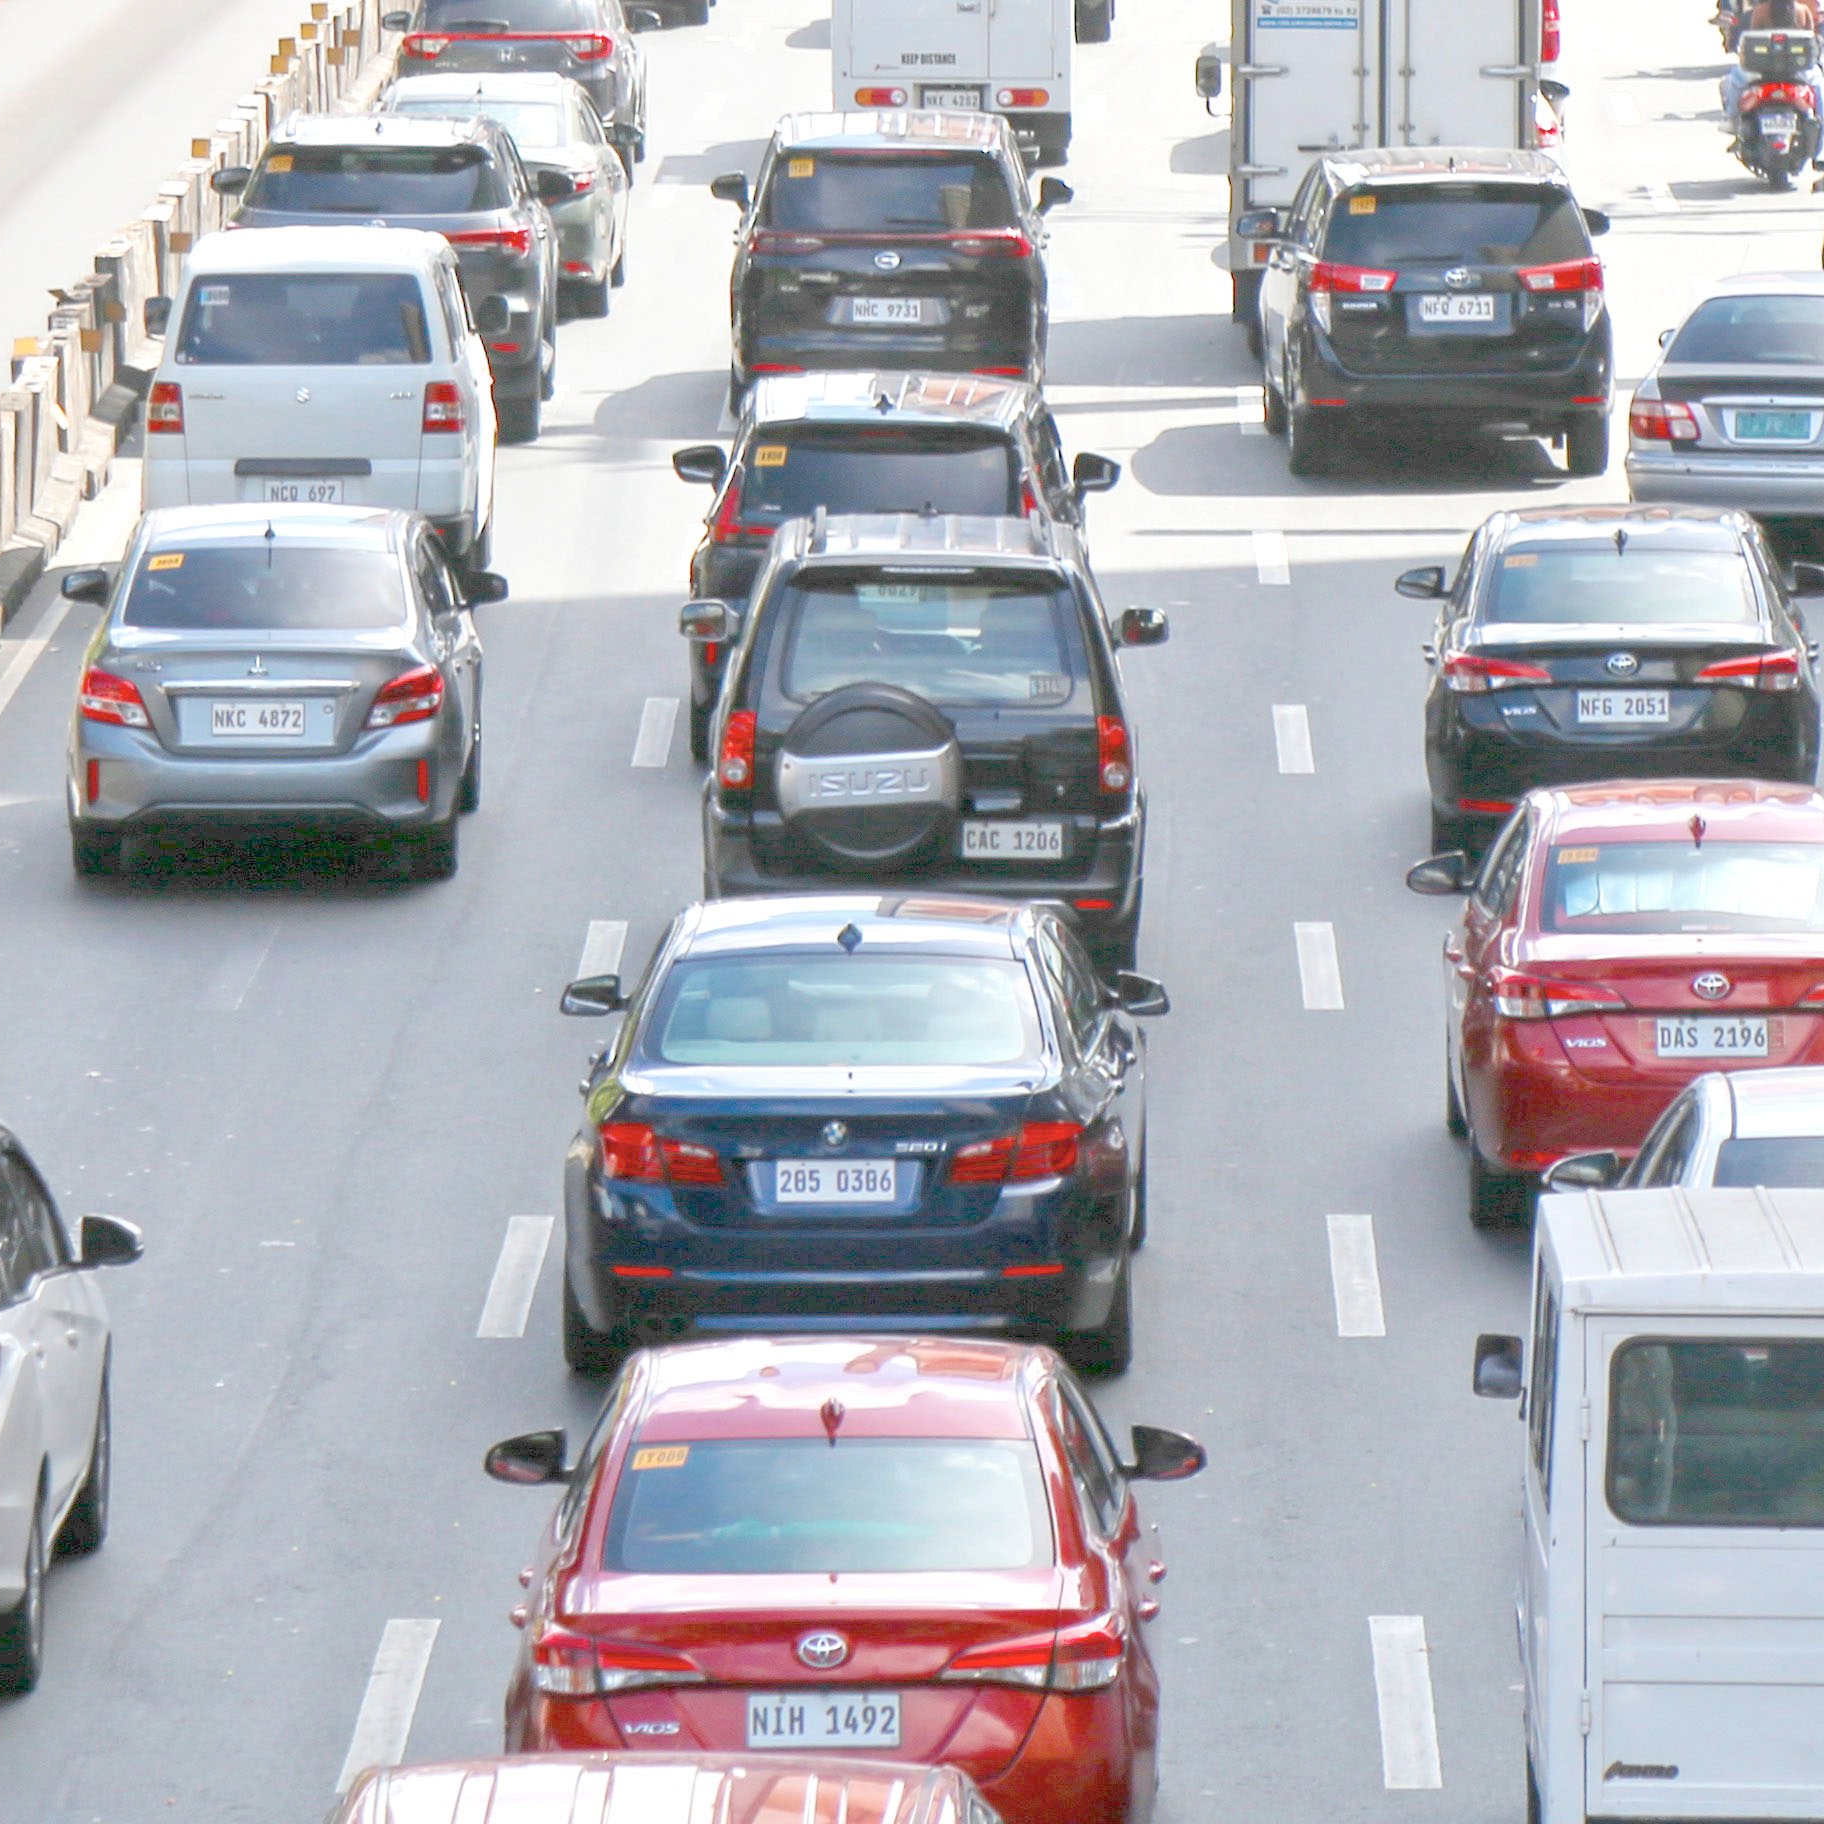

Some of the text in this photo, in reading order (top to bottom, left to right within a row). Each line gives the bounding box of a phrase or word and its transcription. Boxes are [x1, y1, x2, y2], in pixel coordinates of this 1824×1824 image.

[901, 53, 956, 65] KEEP DISTANCE
[886, 303, 919, 317] 9731
[1458, 300, 1492, 316] 6711
[308, 485, 336, 502] 697
[1624, 698, 1667, 716] 2051
[214, 709, 302, 728] NKC 4872
[808, 768, 929, 798] ISUZU
[966, 829, 1060, 851] CAC 1206
[1565, 1038, 1607, 1048] VIOS
[1660, 1027, 1766, 1048] DAS 2196
[895, 1142, 948, 1153] 520i
[624, 1723, 681, 1734] VIOS
[752, 1705, 896, 1735] NIH 1492
